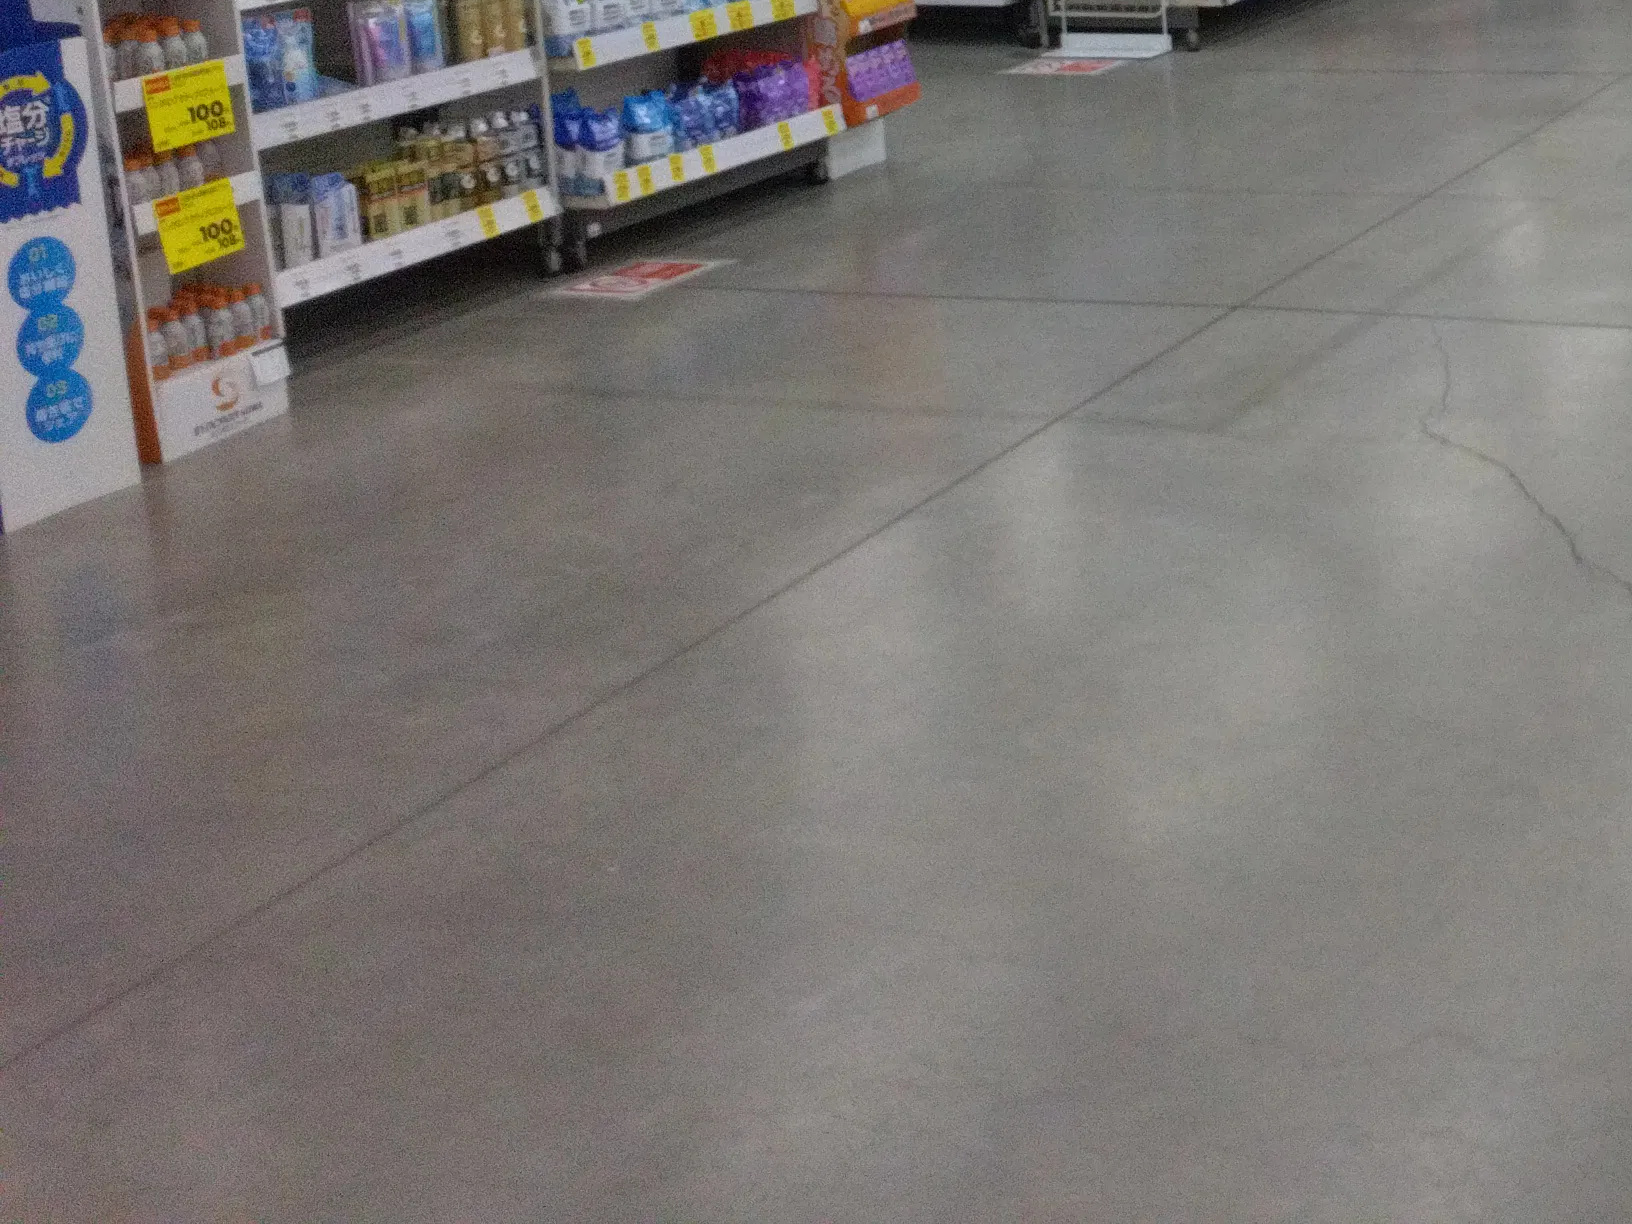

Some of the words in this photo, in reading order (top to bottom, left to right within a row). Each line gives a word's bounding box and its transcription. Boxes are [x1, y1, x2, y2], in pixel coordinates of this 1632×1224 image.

[188, 100, 224, 123] 100
[206, 117, 227, 131] 108
[199, 218, 233, 243] 100
